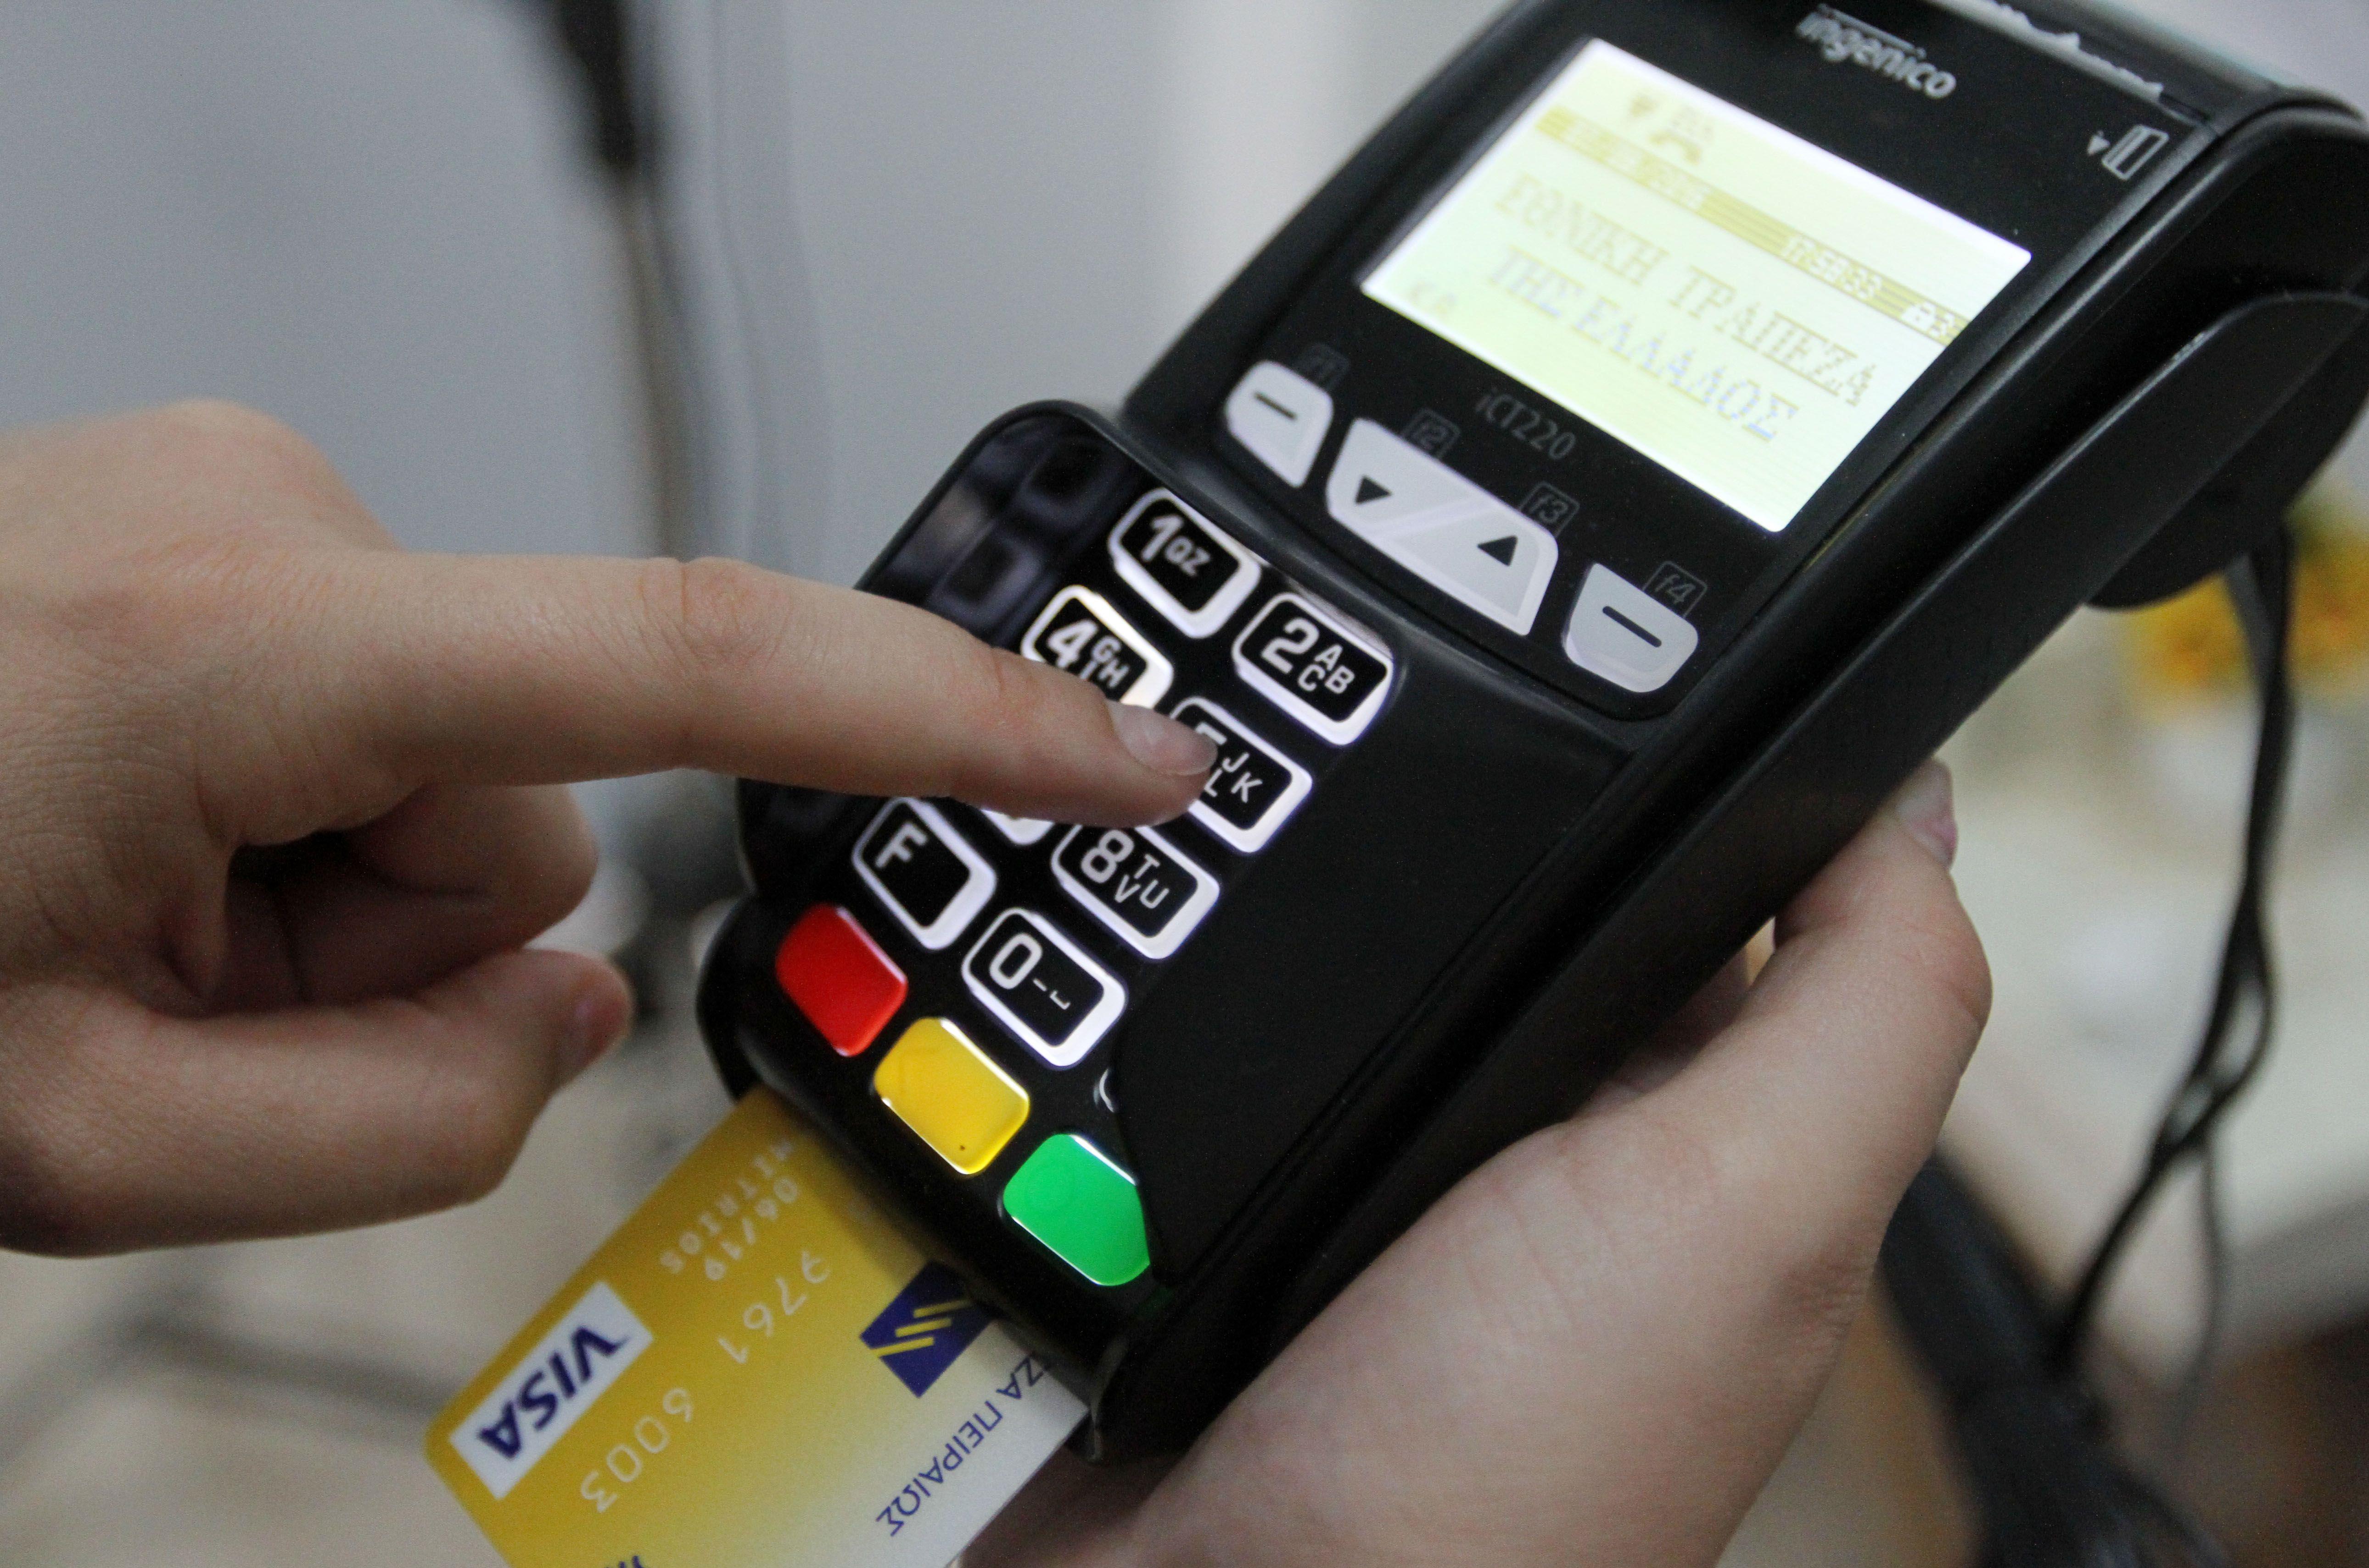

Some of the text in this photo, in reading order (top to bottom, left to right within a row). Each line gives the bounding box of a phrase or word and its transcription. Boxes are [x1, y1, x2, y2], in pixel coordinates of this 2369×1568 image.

[1796, 4, 1956, 98] ingenico
[1493, 172, 1878, 408] ΕΘΝΙΚΗ ΤΡΑΠΕΖΑ
[1475, 389, 1576, 459] iCT220
[1568, 293, 1801, 442] ΕΛΛΑΔΟΣ
[876, 824, 927, 867] F
[478, 1327, 629, 1459] VISA
[579, 1251, 831, 1512] 9761 6003
[875, 1350, 1047, 1536] ΖΑ ΠΕΙΡΑΙΩΣ
